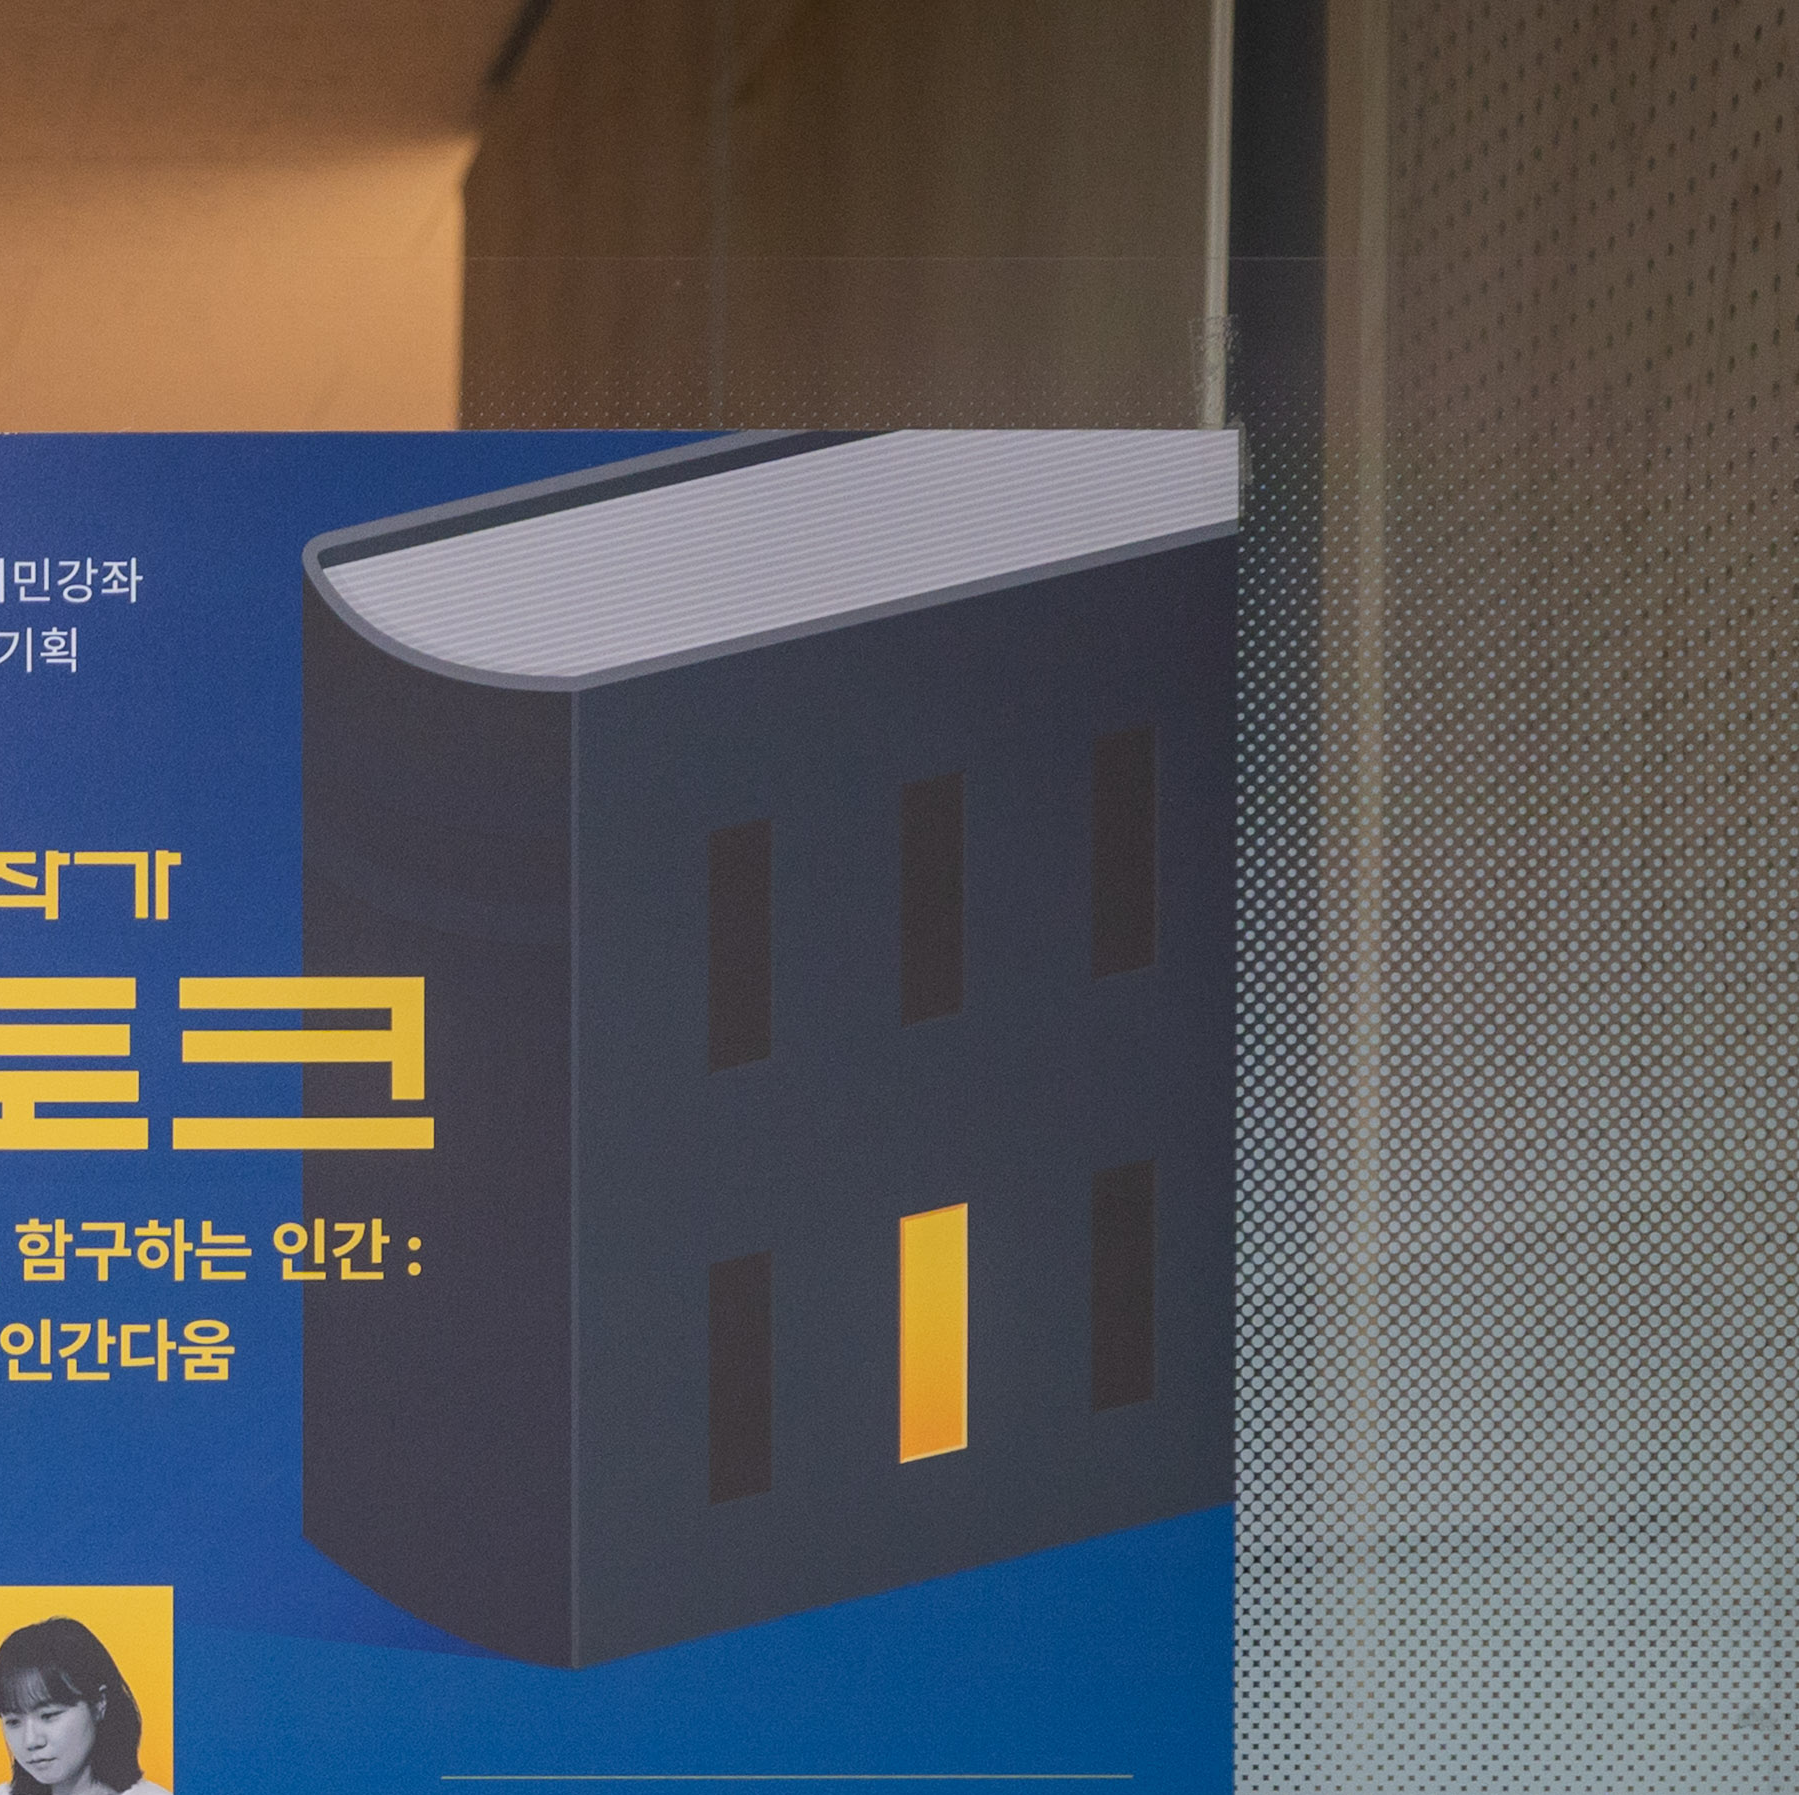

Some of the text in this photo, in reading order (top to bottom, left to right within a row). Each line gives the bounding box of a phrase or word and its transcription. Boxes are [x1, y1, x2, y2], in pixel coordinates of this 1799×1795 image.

[14, 1217, 253, 1282] 함구하는
[272, 1217, 391, 1281] 인간
[0, 1318, 236, 1382] 인간다움
